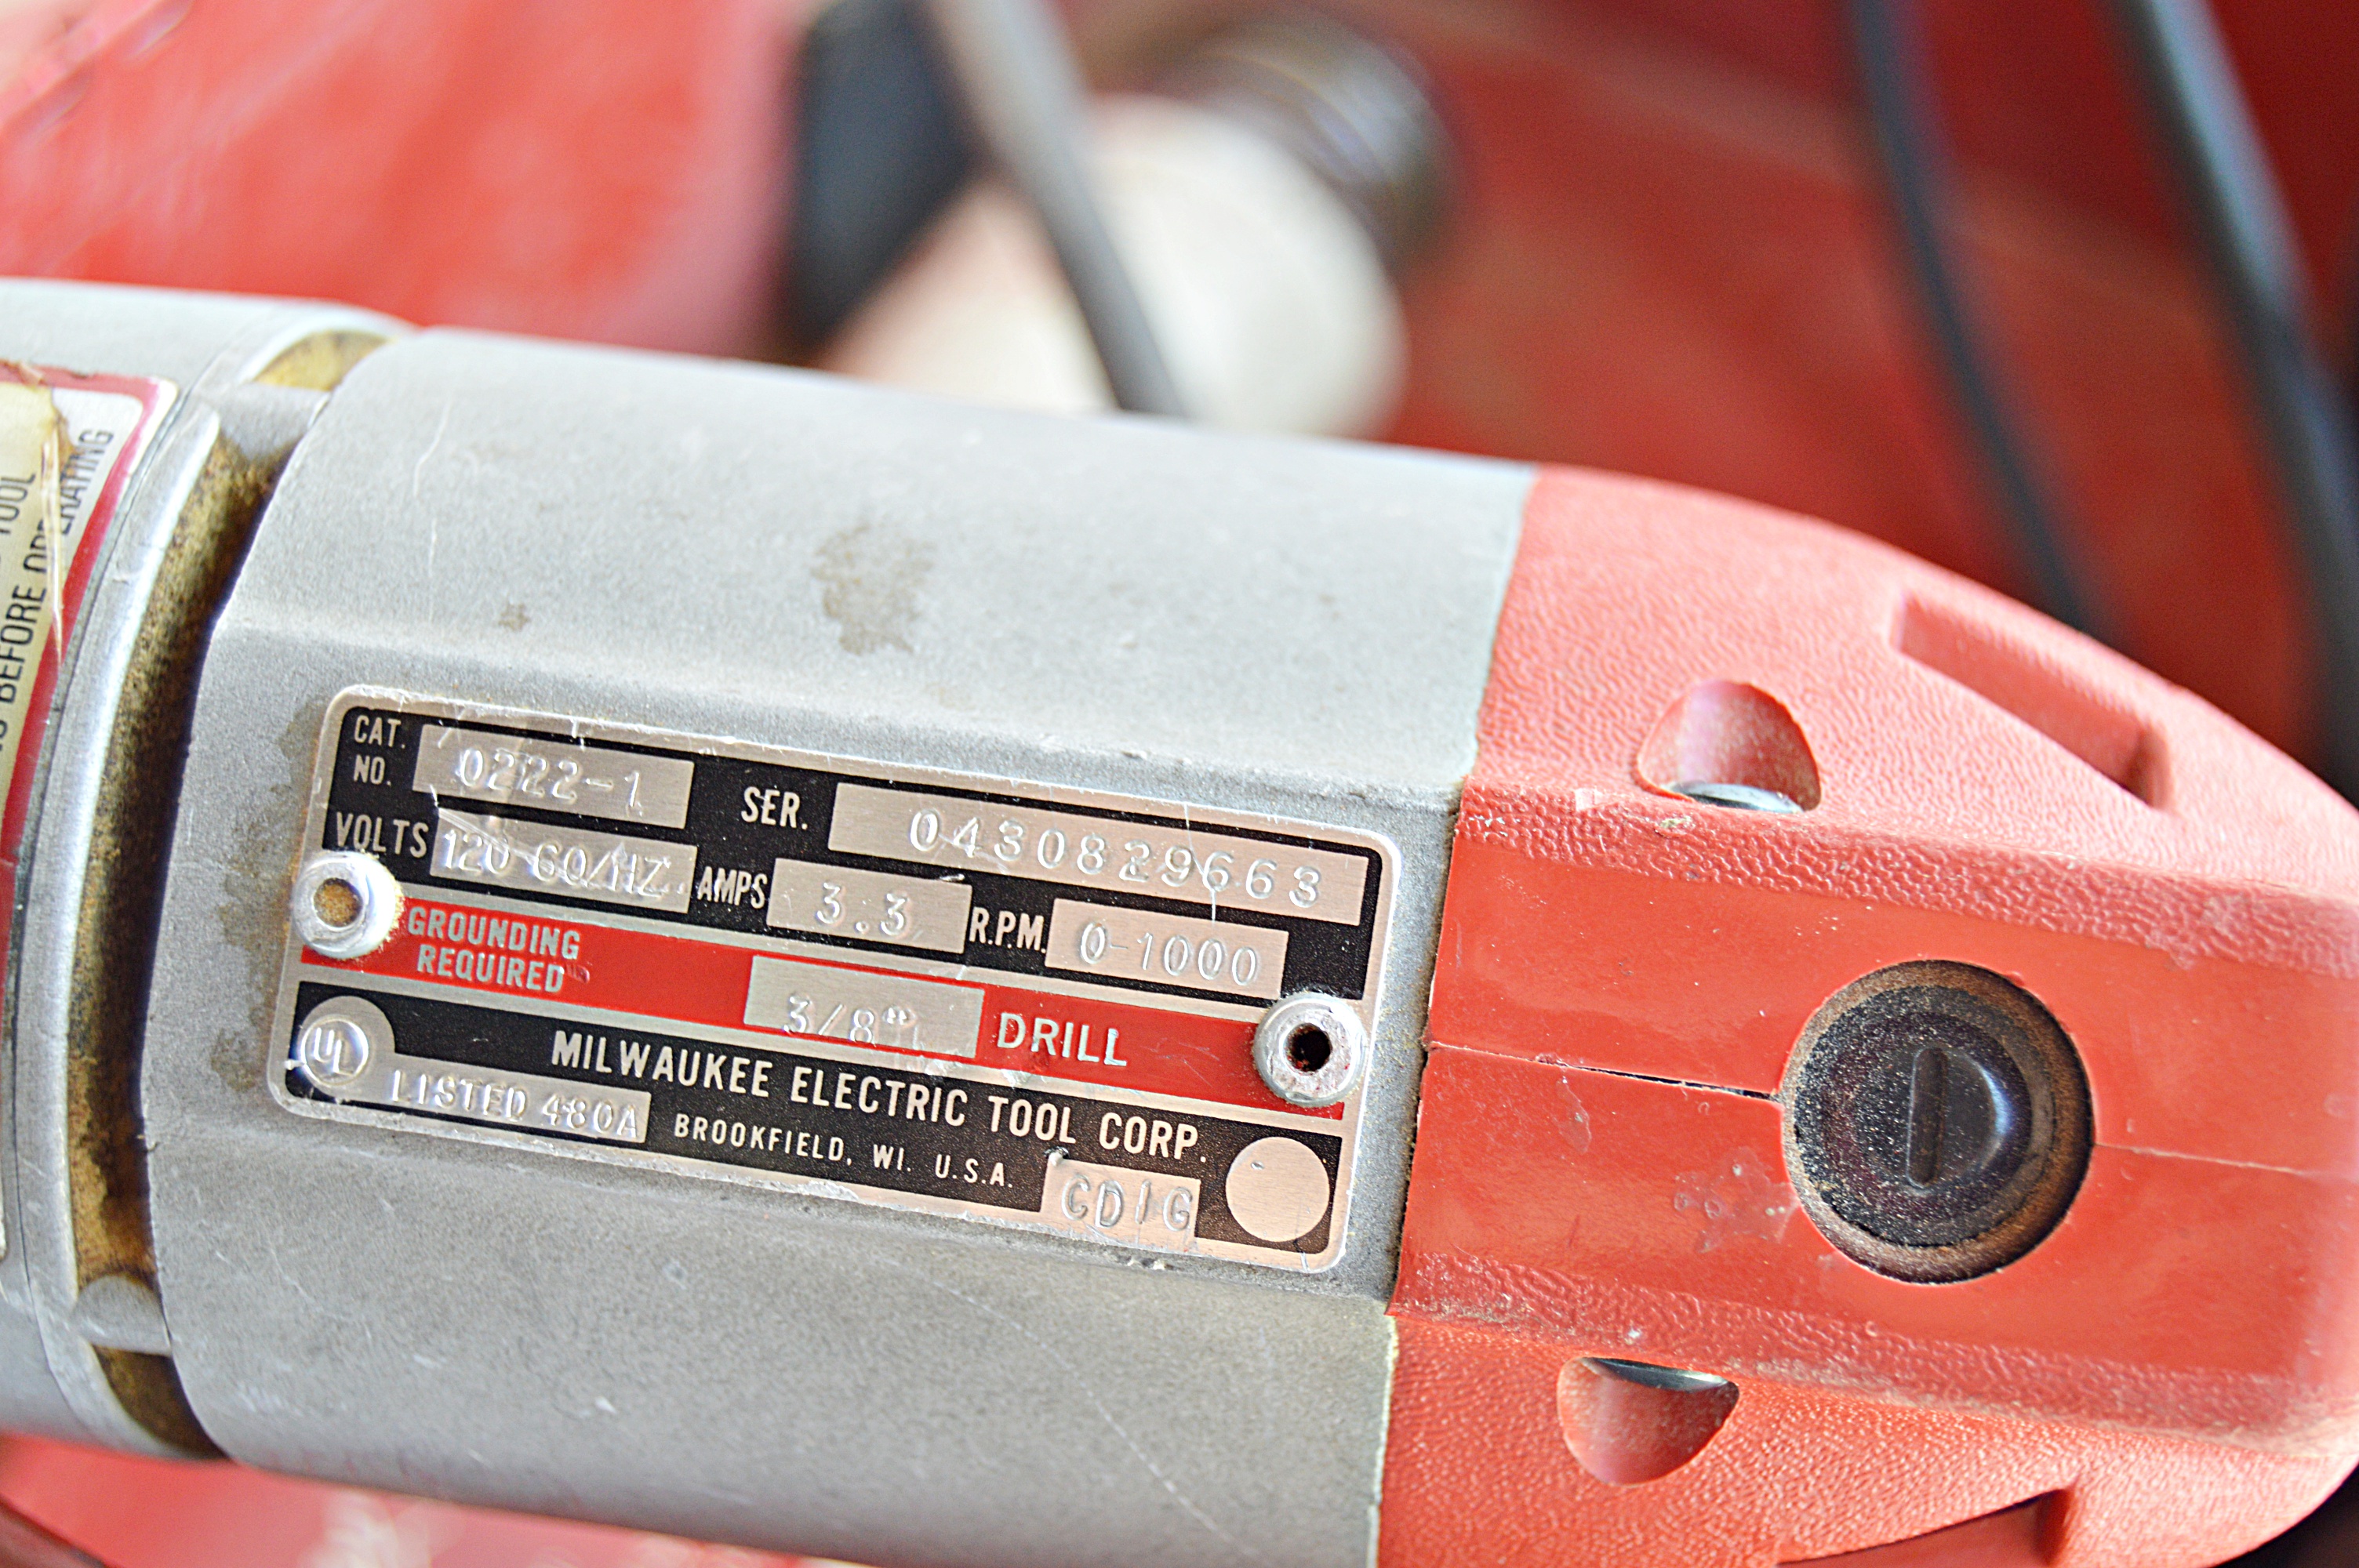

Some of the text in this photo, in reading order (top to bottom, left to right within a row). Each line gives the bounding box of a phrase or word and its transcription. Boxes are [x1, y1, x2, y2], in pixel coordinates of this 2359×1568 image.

[354, 714, 406, 750] CAT.
[353, 756, 391, 786] NO.
[458, 746, 642, 809] 0222-1
[336, 811, 430, 859] VOLTS
[740, 786, 809, 831] SER.
[444, 829, 511, 876] 120
[909, 808, 1322, 908] 0430829663
[696, 866, 769, 909] AMPS
[815, 881, 909, 937] 3.3
[407, 906, 581, 961] GROUNDING
[1079, 920, 1259, 986] 0-1000
[417, 944, 565, 994] REQUIRED
[996, 1011, 1128, 1068] DRILL
[392, 1069, 639, 1139] LISTED 480A
[551, 1030, 1207, 1163] MILWAUKEE ELECTRIC TOOL CORP.
[674, 1112, 1013, 1189] BROOKFIELD, WI. U.S.A.
